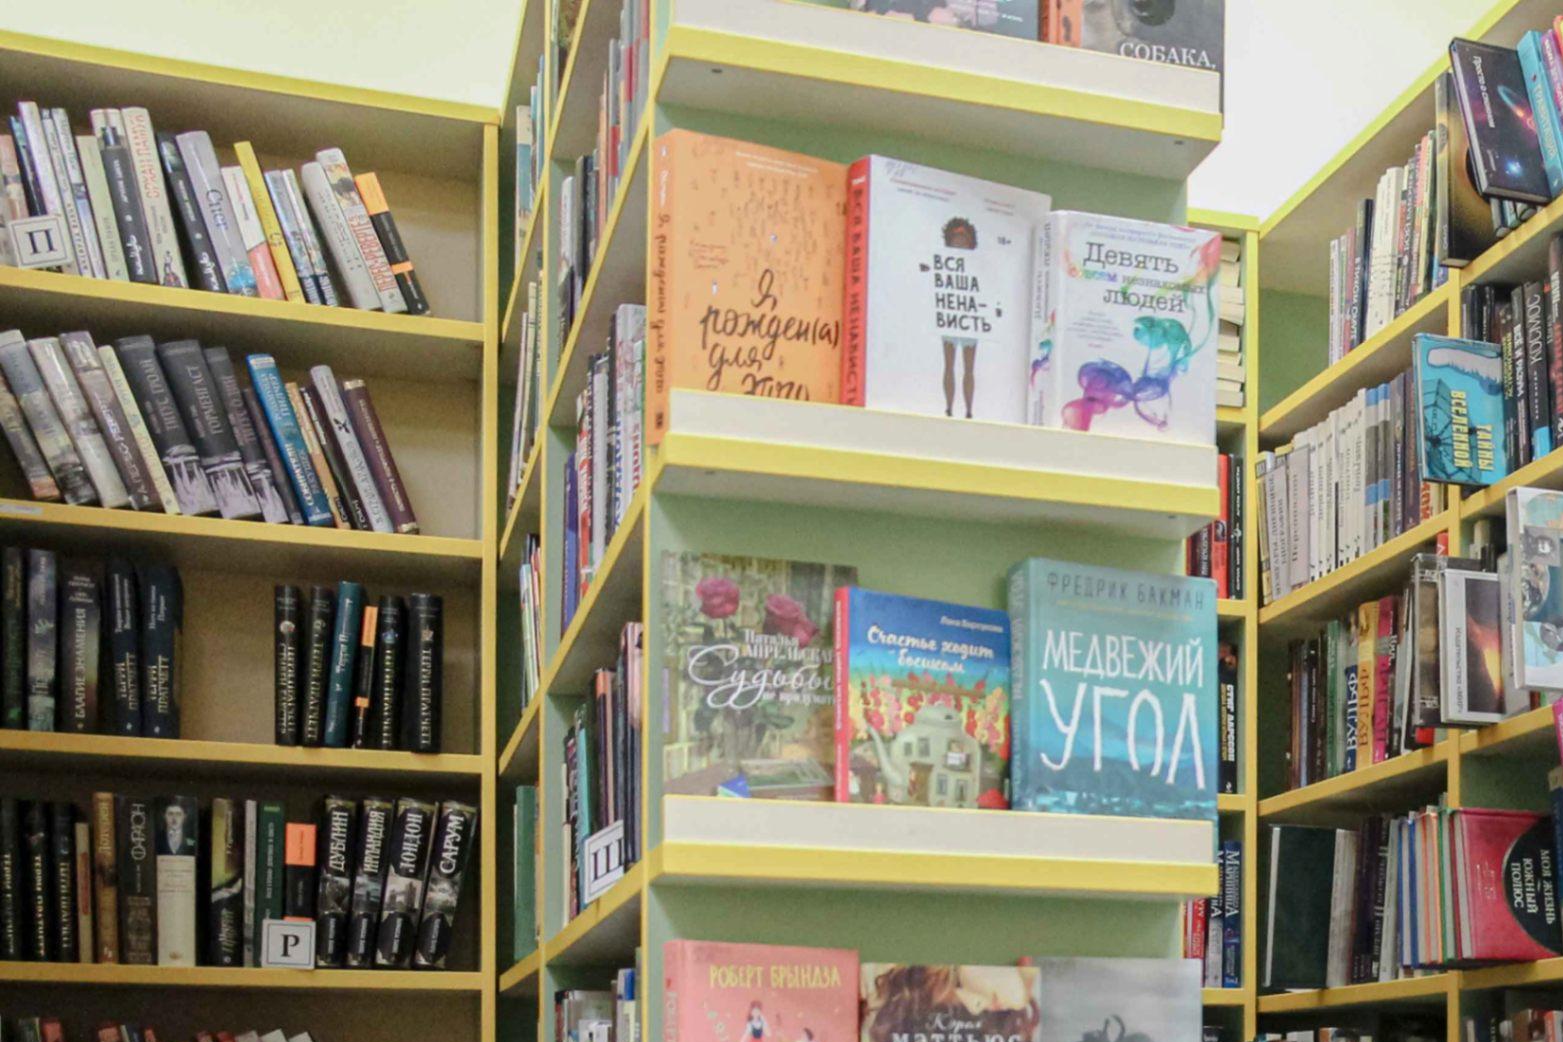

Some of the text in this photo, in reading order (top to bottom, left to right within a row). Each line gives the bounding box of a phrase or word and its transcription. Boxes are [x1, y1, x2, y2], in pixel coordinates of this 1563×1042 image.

[29, 229, 56, 256] П
[1084, 242, 1179, 274] Девять
[934, 255, 964, 272] ВСЯ
[934, 274, 979, 292] ВАША
[751, 269, 777, 309] Я
[935, 294, 987, 312] НЕНА-
[1103, 288, 1187, 313] людей
[700, 303, 840, 360] рожден(а)
[936, 314, 992, 332] ВИСТЬ
[1527, 294, 1544, 365] КОСМОС
[708, 342, 762, 391] для
[1451, 390, 1472, 469] ВСЕЛЕННОЙ
[1477, 424, 1494, 471] ТАЙНЫ
[1045, 571, 1205, 611] ФРЕДРИК БАКМАН
[867, 625, 994, 659] Счастье ходит
[1043, 629, 1203, 687] МЕДВЕЖИЙ
[1040, 677, 1206, 790] УГОЛ
[330, 811, 348, 872] ДУБЛИН
[363, 810, 385, 874] ИРЛАНДИЯ
[400, 812, 423, 873] ЛОНДОН
[439, 814, 464, 875] САРУМ
[281, 934, 300, 957] Р
[709, 962, 842, 989] РОБЕРТ БРЫНДЗА
